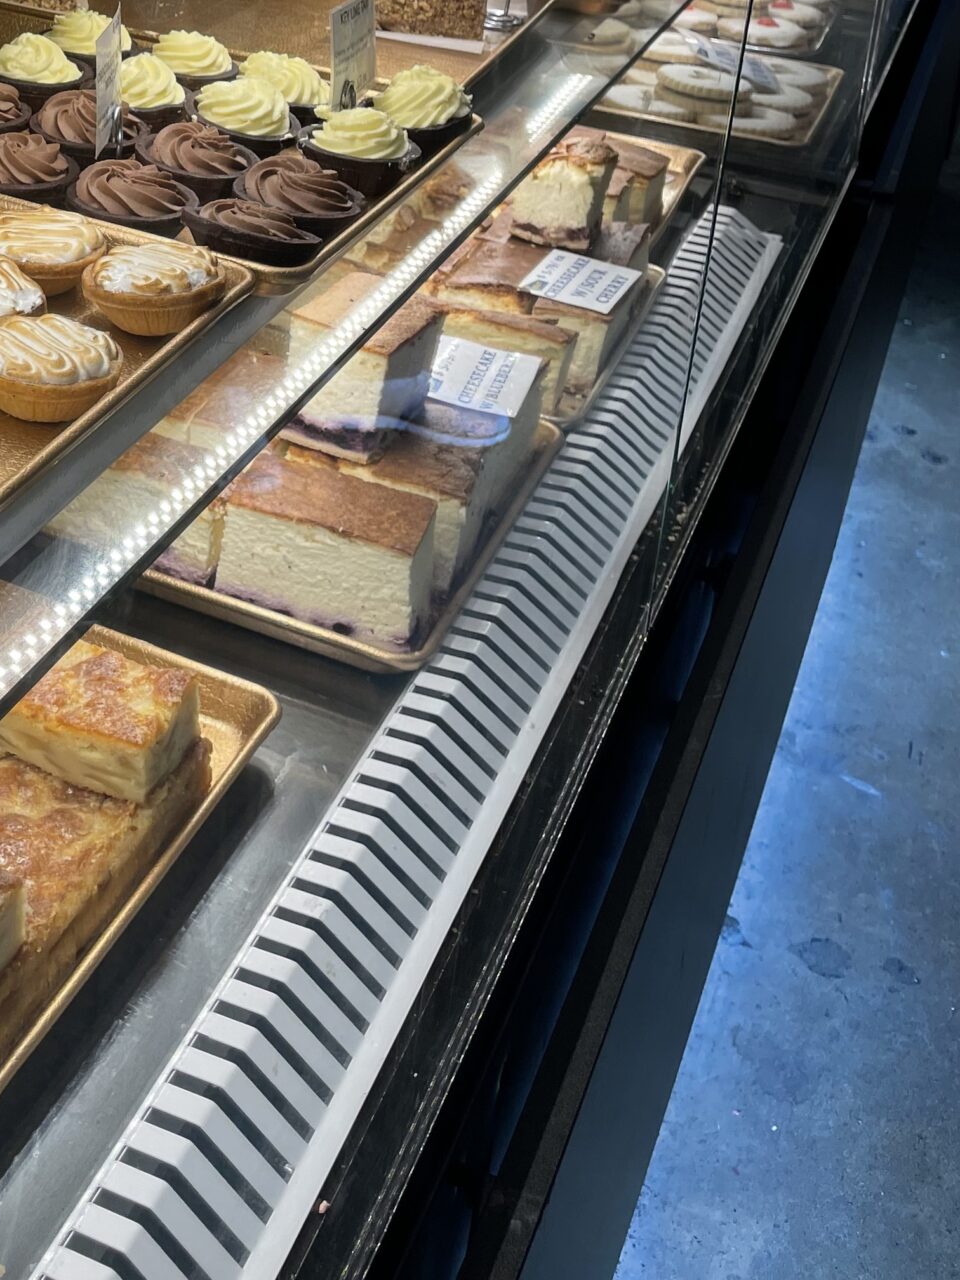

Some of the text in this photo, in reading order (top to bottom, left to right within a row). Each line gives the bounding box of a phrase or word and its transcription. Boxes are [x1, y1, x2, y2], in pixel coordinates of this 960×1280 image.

[544, 257, 591, 298] CHEESECAKE
[596, 274, 629, 304] CHERRY
[458, 350, 497, 404] CHEESECAKE
